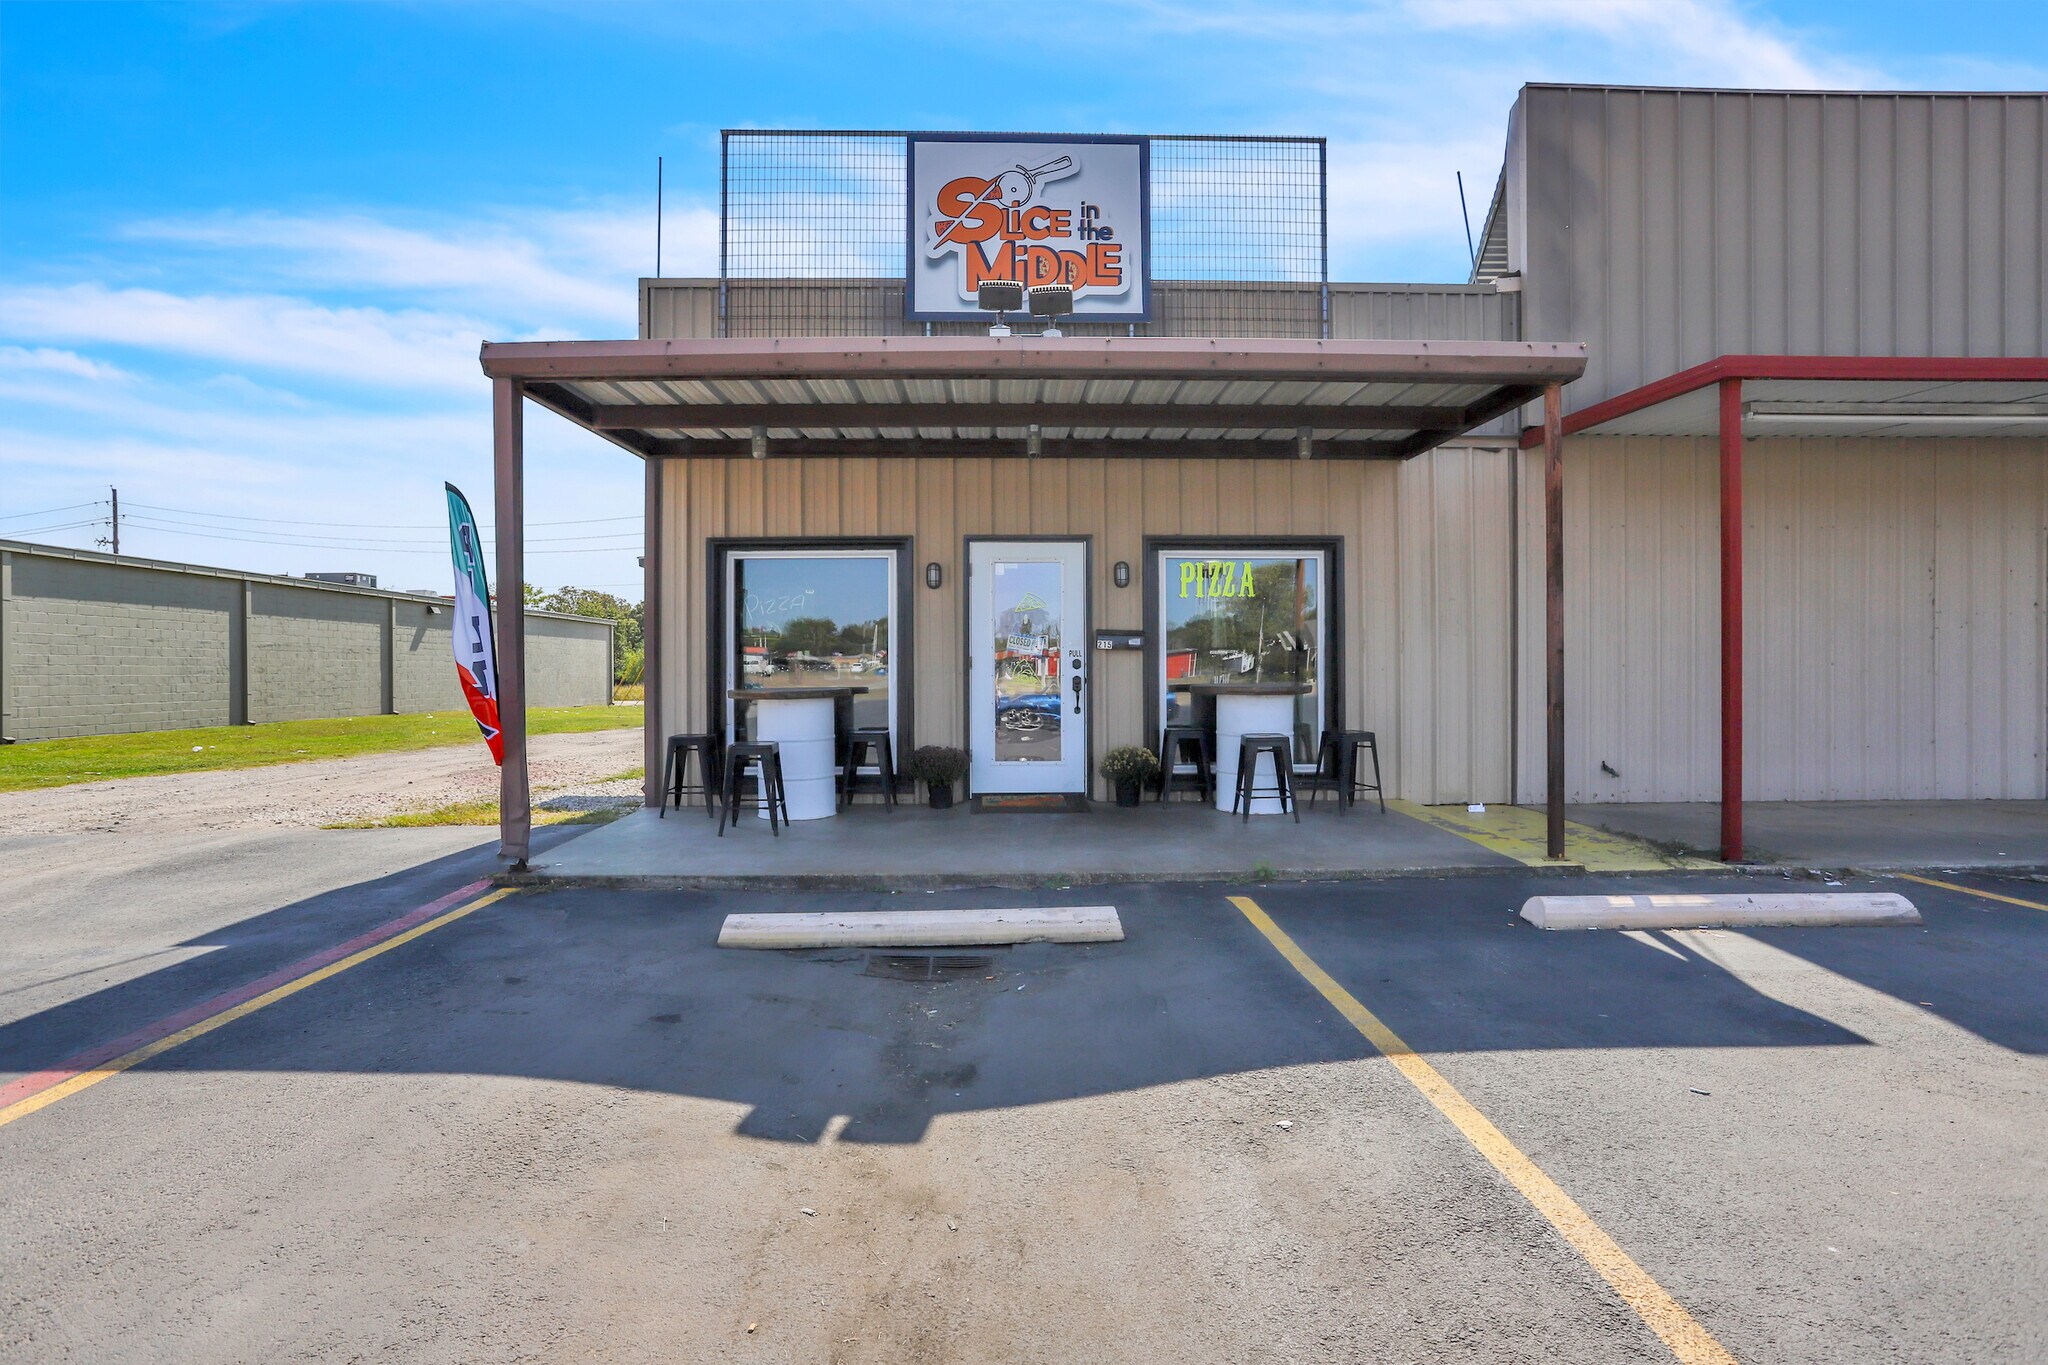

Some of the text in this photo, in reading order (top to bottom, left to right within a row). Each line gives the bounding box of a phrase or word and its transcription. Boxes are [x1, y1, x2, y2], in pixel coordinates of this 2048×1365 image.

[1080, 201, 1100, 219] in
[1078, 218, 1114, 241] the
[1179, 561, 1256, 598] PIZZA
[1008, 635, 1031, 648] CLOSED
[1097, 640, 1112, 649] 215
[1068, 649, 1082, 658] PULL
